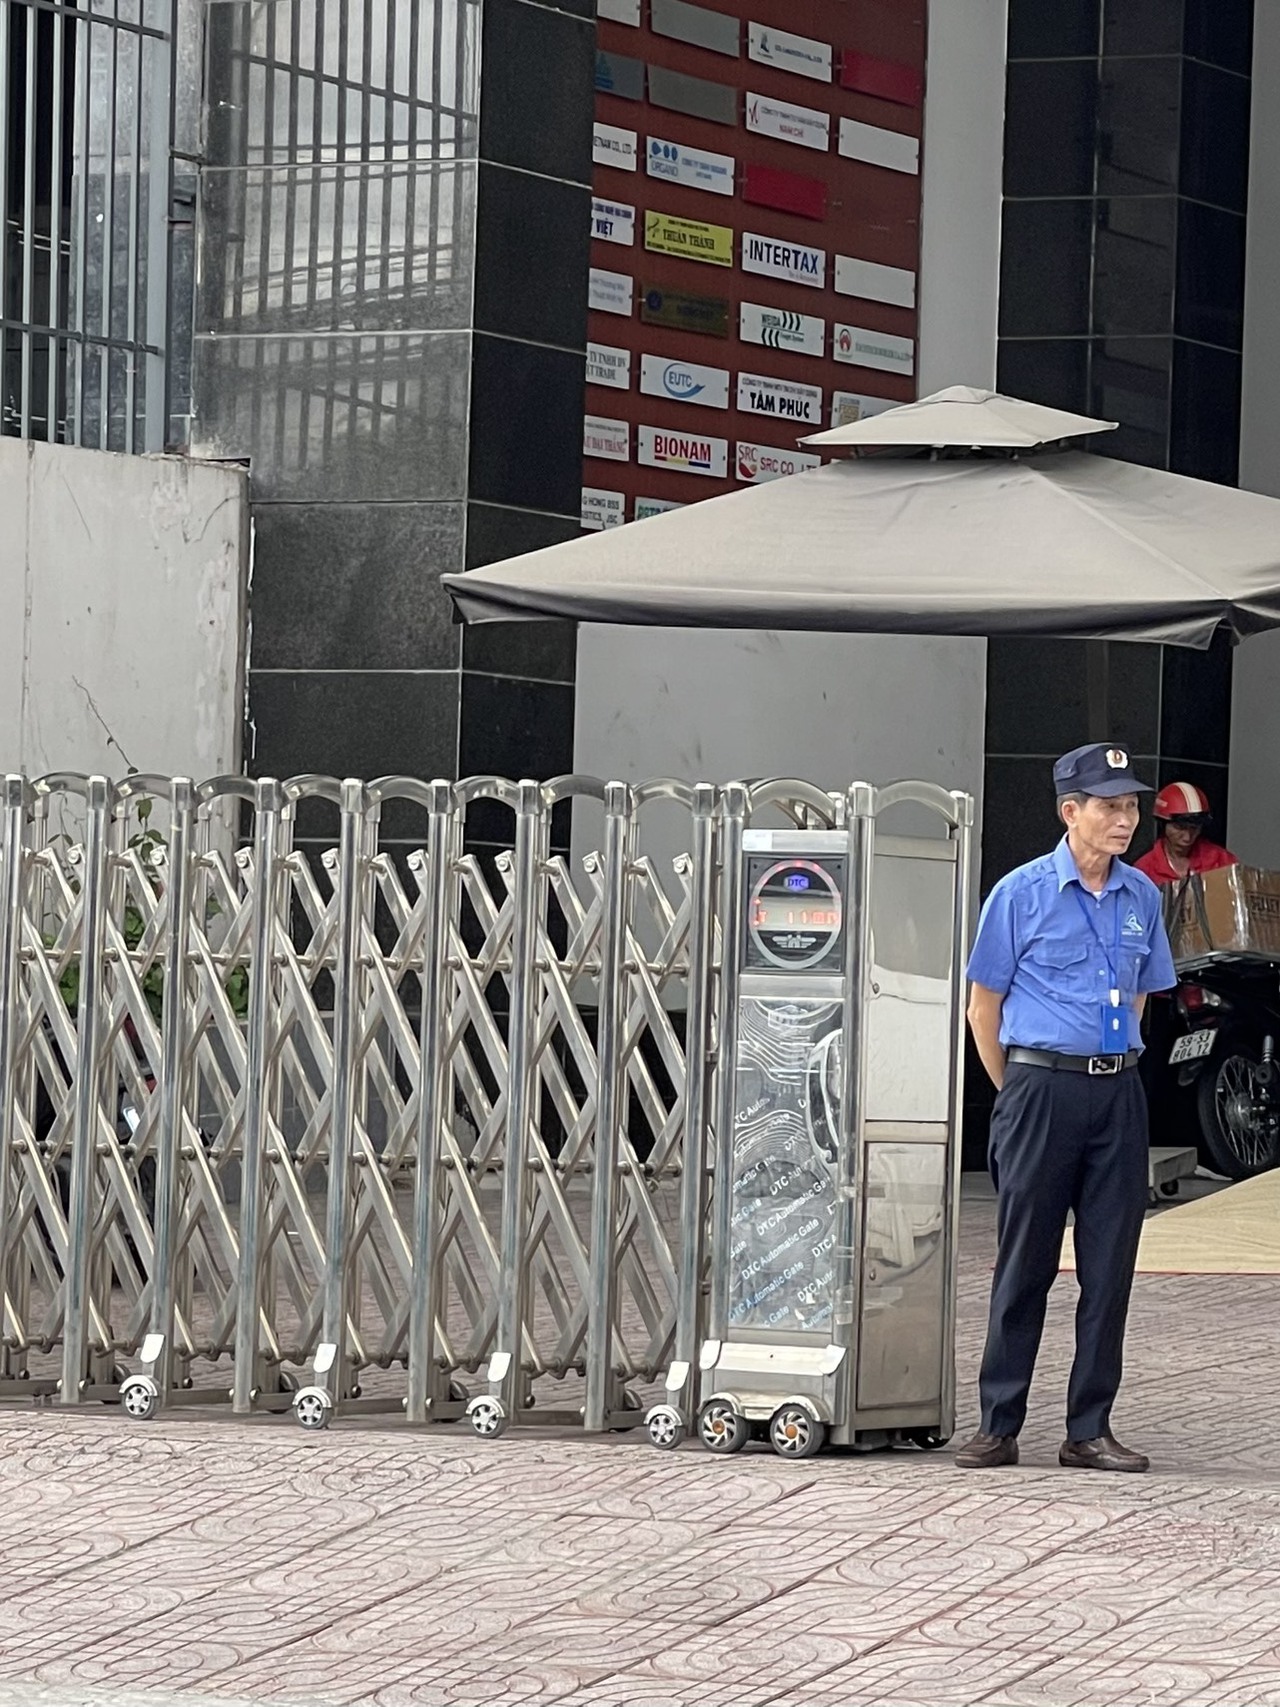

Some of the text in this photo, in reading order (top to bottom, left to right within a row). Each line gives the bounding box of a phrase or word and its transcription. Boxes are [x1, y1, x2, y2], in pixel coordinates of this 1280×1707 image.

[749, 239, 818, 275] INTERTAX
[669, 371, 692, 388] EUTC
[750, 390, 775, 413] TÂM
[654, 434, 711, 463] BIONAM
[738, 445, 758, 462] SRC
[760, 457, 779, 473] SRC
[787, 878, 806, 888] DTC
[769, 1175, 789, 1196] DTC
[756, 1217, 777, 1236] DTC
[741, 1218, 820, 1280] DTC Automatic Gate
[745, 1275, 785, 1309] Automatic
[783, 1261, 805, 1280] Gate
[811, 1238, 832, 1258] DTC
[769, 1305, 790, 1323] Gate
